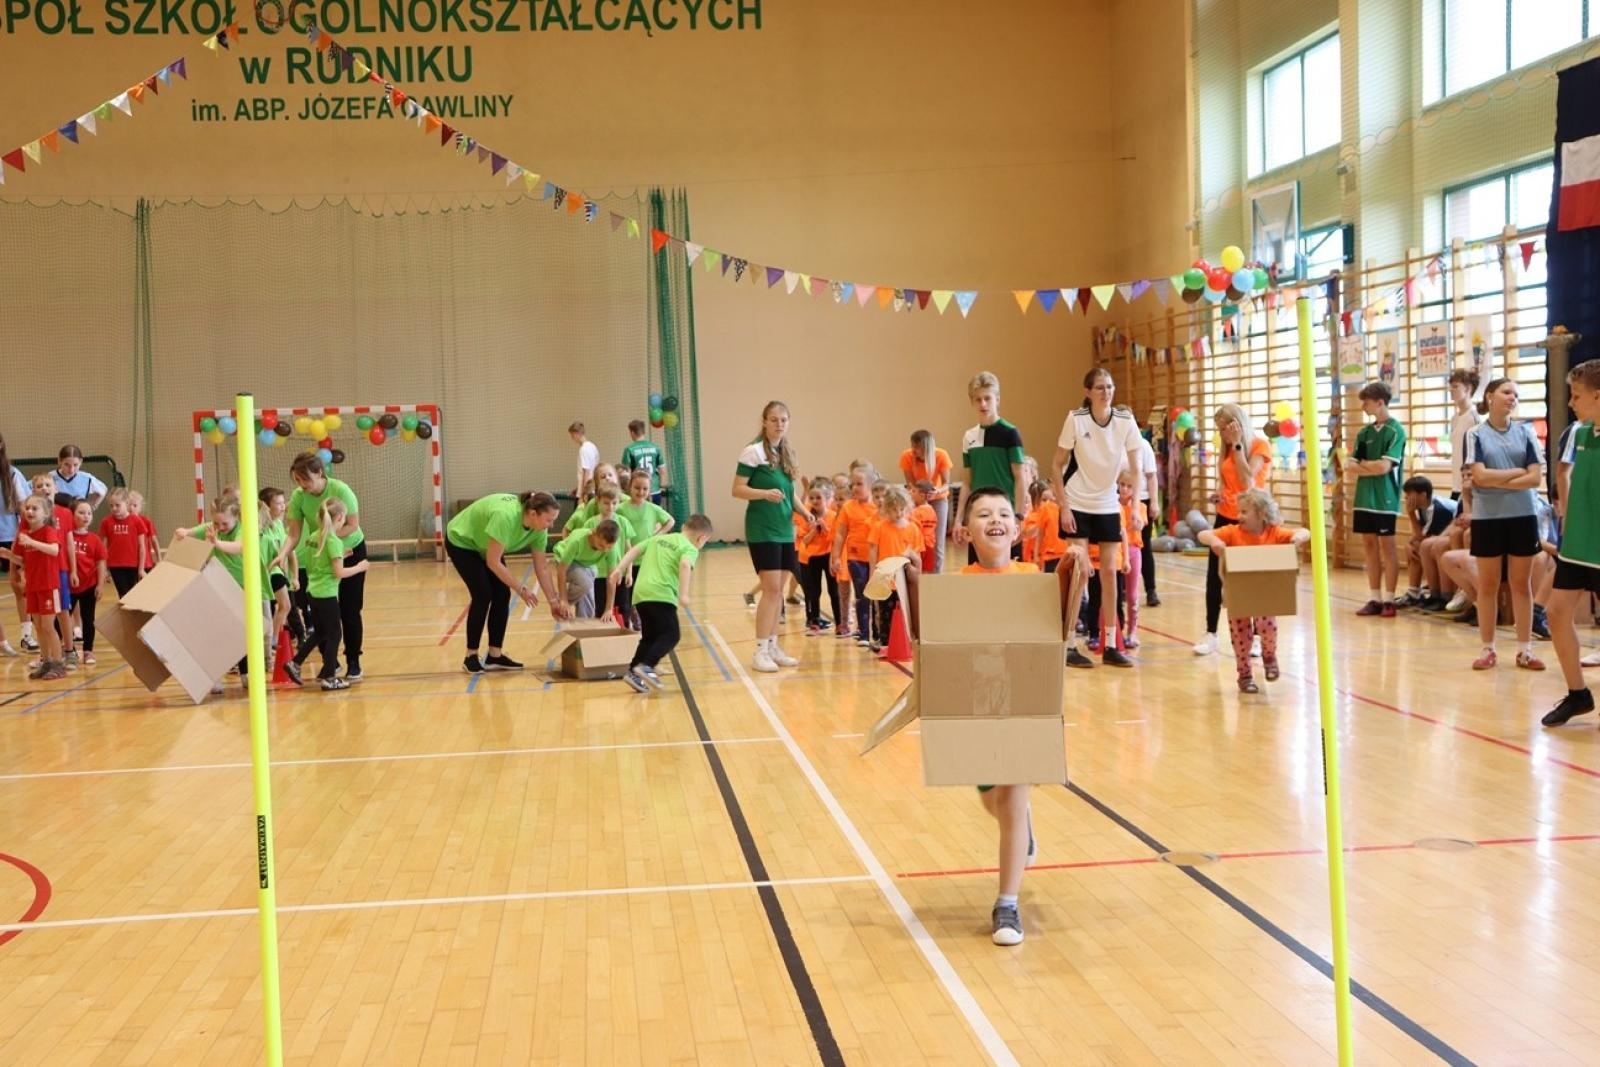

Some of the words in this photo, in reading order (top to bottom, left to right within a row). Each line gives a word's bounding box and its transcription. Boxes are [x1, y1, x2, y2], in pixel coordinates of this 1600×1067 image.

[286, 46, 473, 84] RUDNIKU
[192, 99, 227, 121] im.
[234, 98, 290, 121] ABP.
[298, 92, 394, 120] JÓZEFA
[638, 456, 654, 474] 15
